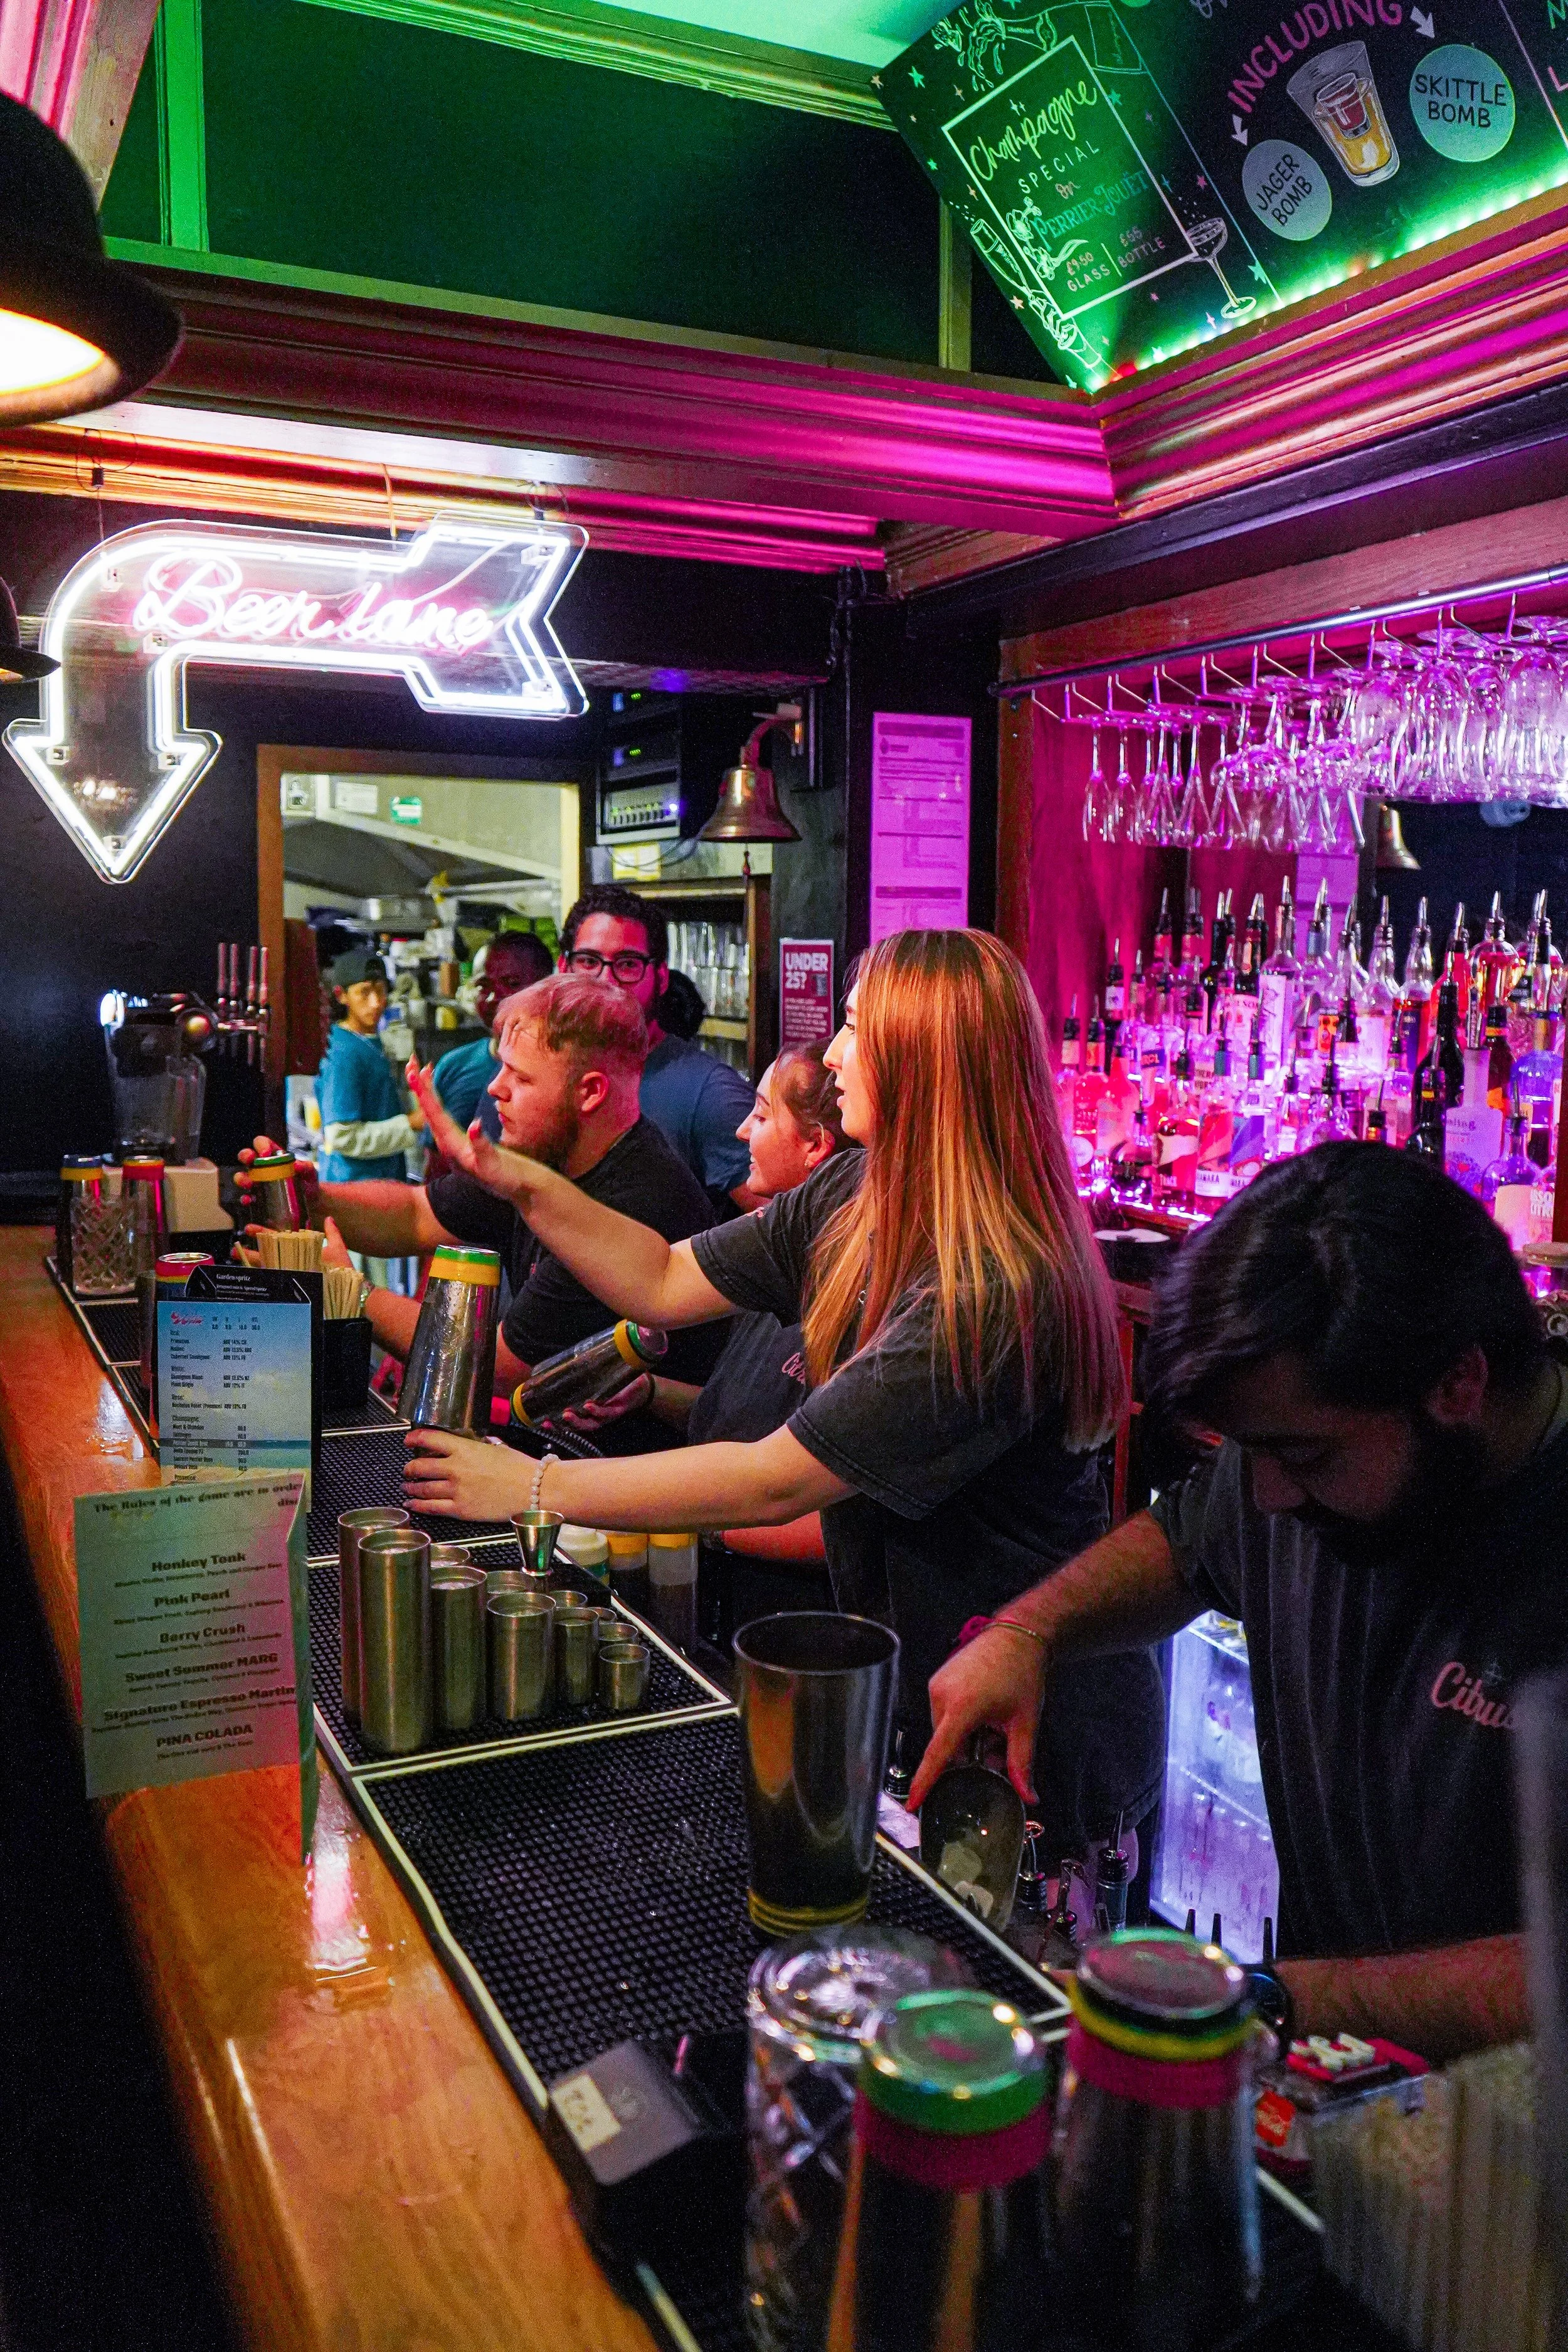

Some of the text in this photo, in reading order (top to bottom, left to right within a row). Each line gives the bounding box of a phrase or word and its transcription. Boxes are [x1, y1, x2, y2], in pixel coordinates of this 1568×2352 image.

[1227, 0, 1403, 114] INCLUDING
[1414, 74, 1507, 107] SKITTLE
[970, 79, 1098, 181] Champagne
[1428, 101, 1492, 129] BOMB
[1018, 140, 1099, 194] SPECIAL
[1256, 154, 1300, 211] JAGER
[1273, 177, 1313, 227] BOMB
[1118, 236, 1165, 268] BOTTLE
[1067, 264, 1110, 292] GLASS
[133, 552, 335, 638] Beer
[785, 952, 829, 972] UNDER
[781, 1352, 805, 1385] Citr
[152, 1552, 246, 1572] Honkey Tonk
[154, 1588, 231, 1608] Pink Pearl
[159, 1623, 245, 1645] Berry Crush
[125, 1668, 170, 1683] Sweet
[172, 1661, 235, 1675] Summer
[237, 1653, 278, 1666] MARG
[104, 1703, 177, 1722] Signature
[180, 1693, 246, 1710] Espresso
[248, 1686, 295, 1700] Martin
[1431, 1660, 1515, 1729] Citru
[194, 1724, 253, 1741] COLADA
